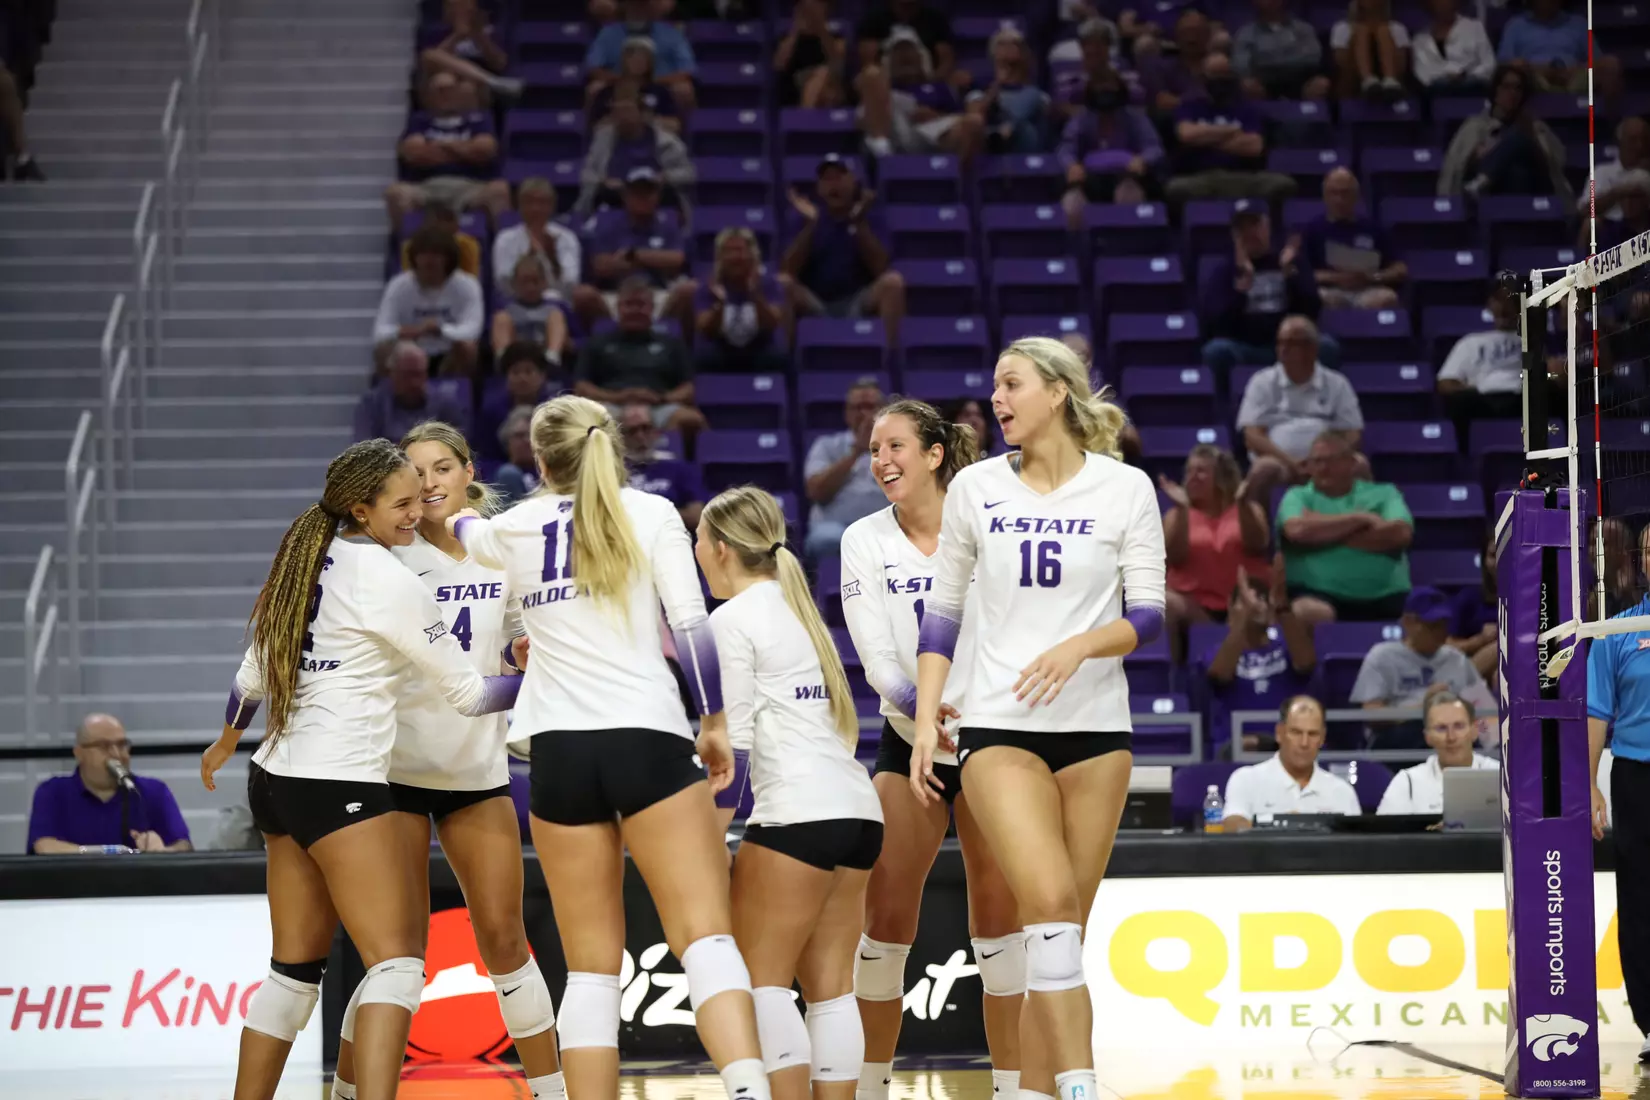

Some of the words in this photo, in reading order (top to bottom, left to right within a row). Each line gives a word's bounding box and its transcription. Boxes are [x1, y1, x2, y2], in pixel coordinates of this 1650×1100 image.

[989, 516, 1096, 535] K-STATE
[1019, 540, 1062, 588] 16
[435, 582, 502, 602] STATE
[887, 576, 934, 594] K-ST
[450, 606, 472, 652] 4
[299, 657, 341, 673] CATS
[1543, 850, 1564, 914] sports
[1108, 908, 1624, 1026] QDO
[0, 985, 112, 1031] HIE
[1240, 1001, 1509, 1027] MEXICAN
[1532, 1080, 1552, 1088] (800)
[1553, 1079, 1587, 1087] 556-3198
